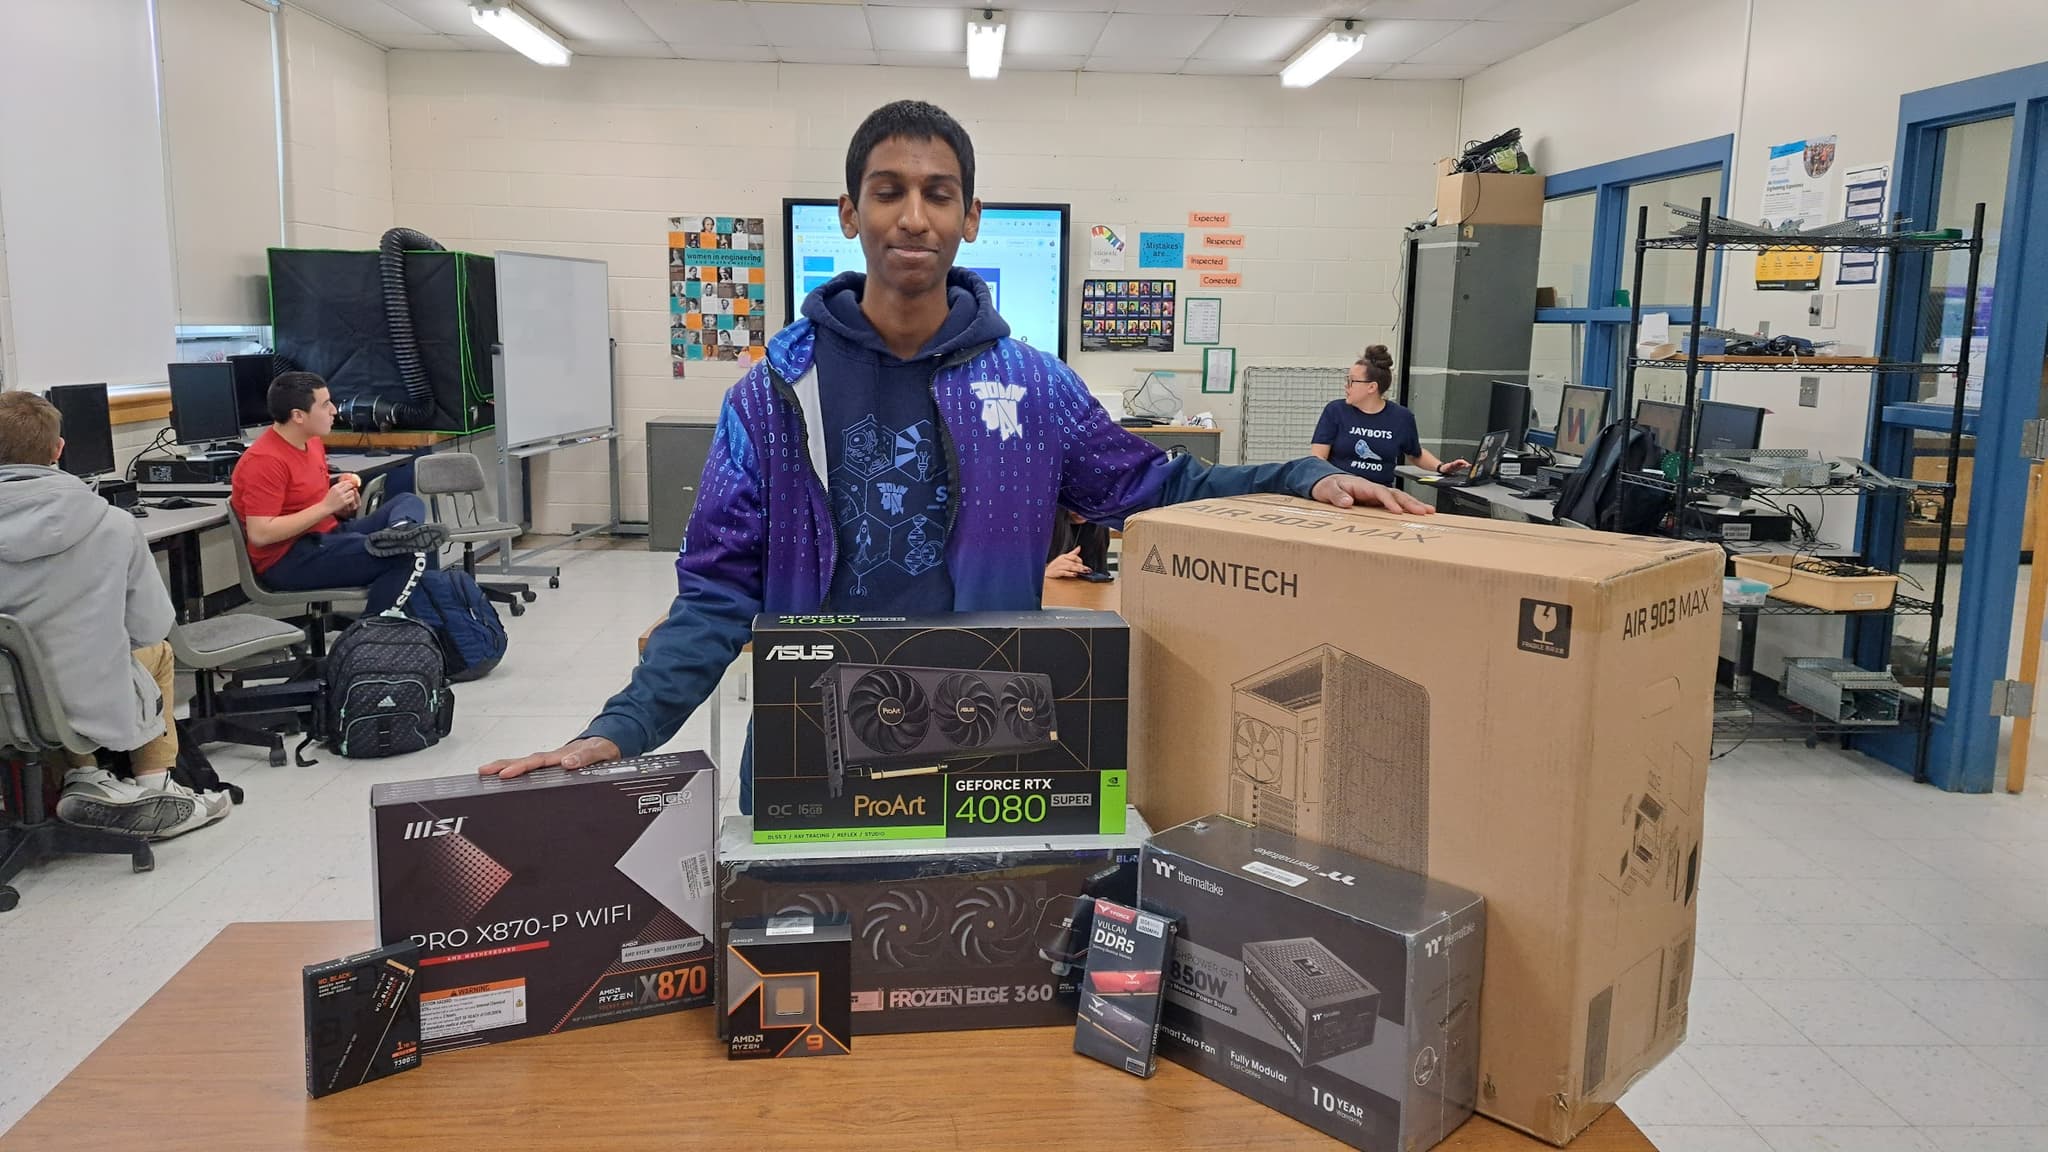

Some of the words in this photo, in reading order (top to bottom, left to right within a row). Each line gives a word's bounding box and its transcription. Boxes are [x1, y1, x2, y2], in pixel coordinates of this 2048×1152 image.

[1194, 214, 1226, 222] Expected
[1146, 242, 1178, 250] Mistakes
[1206, 237, 1241, 246] Respected
[721, 254, 761, 262] engineering
[1349, 426, 1392, 440] JAYBOTS
[1350, 460, 1382, 472] #16700
[1181, 504, 1252, 518] AIR
[1250, 513, 1332, 530] 903
[1332, 525, 1442, 544] MAX
[1172, 554, 1298, 598] MONTECH
[1623, 608, 1646, 640] AIR
[1651, 598, 1676, 630] 903
[1680, 587, 1710, 620] MAX
[765, 644, 834, 661] ASUS
[956, 780, 1020, 791] GEFORCE
[1024, 778, 1052, 790] RTX
[768, 804, 792, 816] OC
[854, 794, 926, 816] ProArt
[955, 794, 1046, 824] 4080
[1052, 795, 1089, 805] SUPER
[1116, 855, 1138, 863] BLA
[1178, 871, 1224, 896] thermaltake
[476, 914, 568, 944] X870-P
[576, 904, 631, 929] WIFI
[1098, 920, 1128, 936] VULCAN
[1094, 928, 1136, 954] DDR5
[640, 966, 706, 1003] X870
[1171, 960, 1228, 998] 850W
[458, 985, 490, 996] WARNING
[599, 992, 634, 1004] RYZEN
[600, 988, 616, 996] AMD
[890, 988, 962, 1008] FROZEN
[966, 986, 1010, 1004] EDGE
[1014, 984, 1052, 1002] 360
[1174, 984, 1196, 997] Modular
[1196, 992, 1213, 1005] Power
[1214, 1000, 1232, 1014] Supply
[732, 1036, 756, 1044] AMD
[806, 1034, 824, 1050] 9
[1182, 1032, 1199, 1048] Zero
[1200, 1041, 1216, 1055] Fan
[1230, 1050, 1250, 1066] Fully
[1252, 1060, 1288, 1083] Modular
[1312, 1086, 1334, 1112] 10
[1336, 1098, 1364, 1118] YEAR
